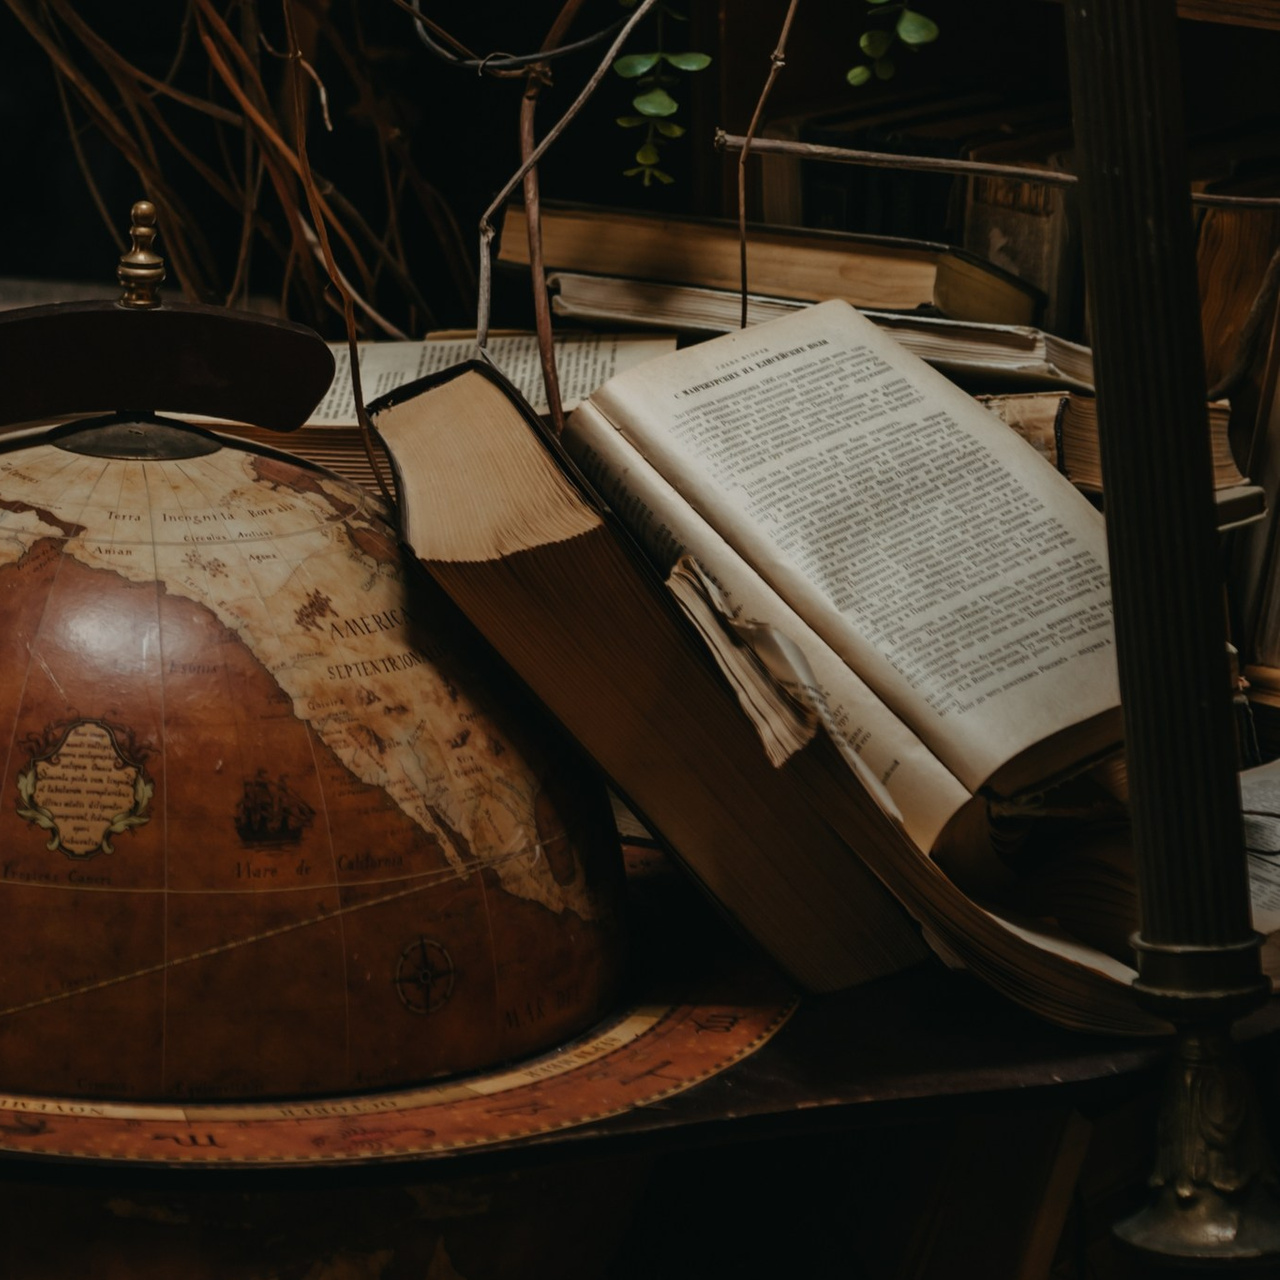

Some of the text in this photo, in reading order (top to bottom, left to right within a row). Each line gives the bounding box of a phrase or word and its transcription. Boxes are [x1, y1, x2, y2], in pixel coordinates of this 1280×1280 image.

[681, 371, 740, 395] МАНЧЖУРСКИХ
[741, 366, 754, 374] НА
[754, 346, 807, 368] ЕЛИСЕЙСКИЕ
[806, 339, 828, 349] ПОЛЯ
[107, 502, 298, 525] Terra Incognita Borealis
[94, 546, 133, 556] Anian
[328, 642, 448, 680] SEPTENTRION
[338, 851, 406, 872] California
[280, 1101, 397, 1118] OCTOBER
